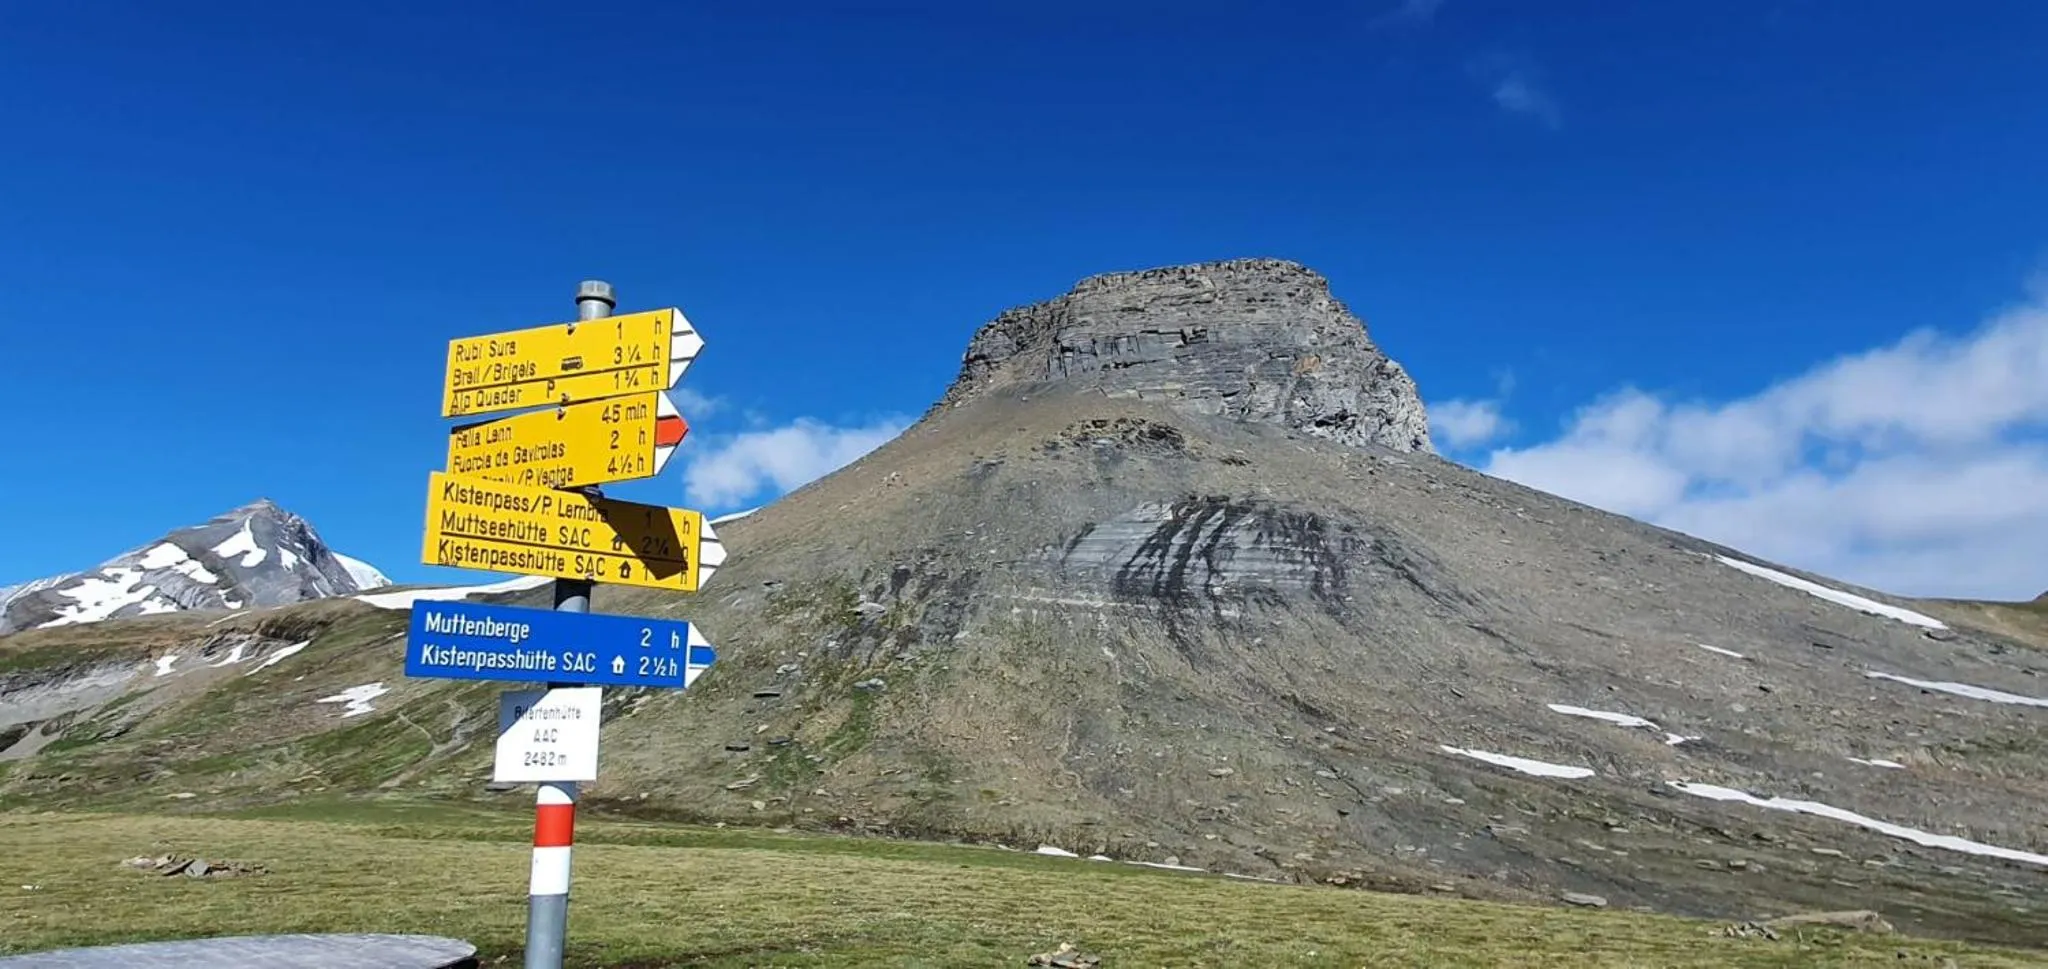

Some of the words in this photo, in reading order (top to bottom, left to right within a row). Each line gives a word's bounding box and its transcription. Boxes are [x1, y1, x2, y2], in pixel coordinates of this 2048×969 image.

[456, 342, 482, 362] Rubi
[489, 340, 516, 358] Sura
[616, 321, 622, 340] 1
[655, 317, 661, 335] h
[652, 341, 660, 360] h
[451, 388, 470, 410] Alp
[476, 385, 522, 407] Quader
[651, 366, 659, 385] h
[602, 404, 621, 424] 45
[626, 401, 647, 421] min
[453, 453, 491, 474] Fuorcla
[514, 440, 565, 464] Gavirolas
[610, 430, 619, 449] 2
[639, 427, 645, 445] h
[637, 453, 644, 472] h
[440, 508, 547, 542] Muttseehütte
[559, 526, 590, 548] SAC
[558, 496, 608, 522] Lembra
[683, 516, 690, 534] h
[438, 538, 565, 571] Kistenpasshütte
[575, 554, 606, 577] SAC
[425, 611, 530, 643] Muttenberge
[641, 628, 652, 647] 2
[671, 630, 680, 649] h
[421, 643, 556, 672] Kistenpasshütte
[563, 652, 596, 672] SAC
[669, 657, 678, 677] h
[514, 704, 581, 720] Bifertenhütte
[533, 728, 559, 743] AAC
[523, 751, 556, 766] 2482
